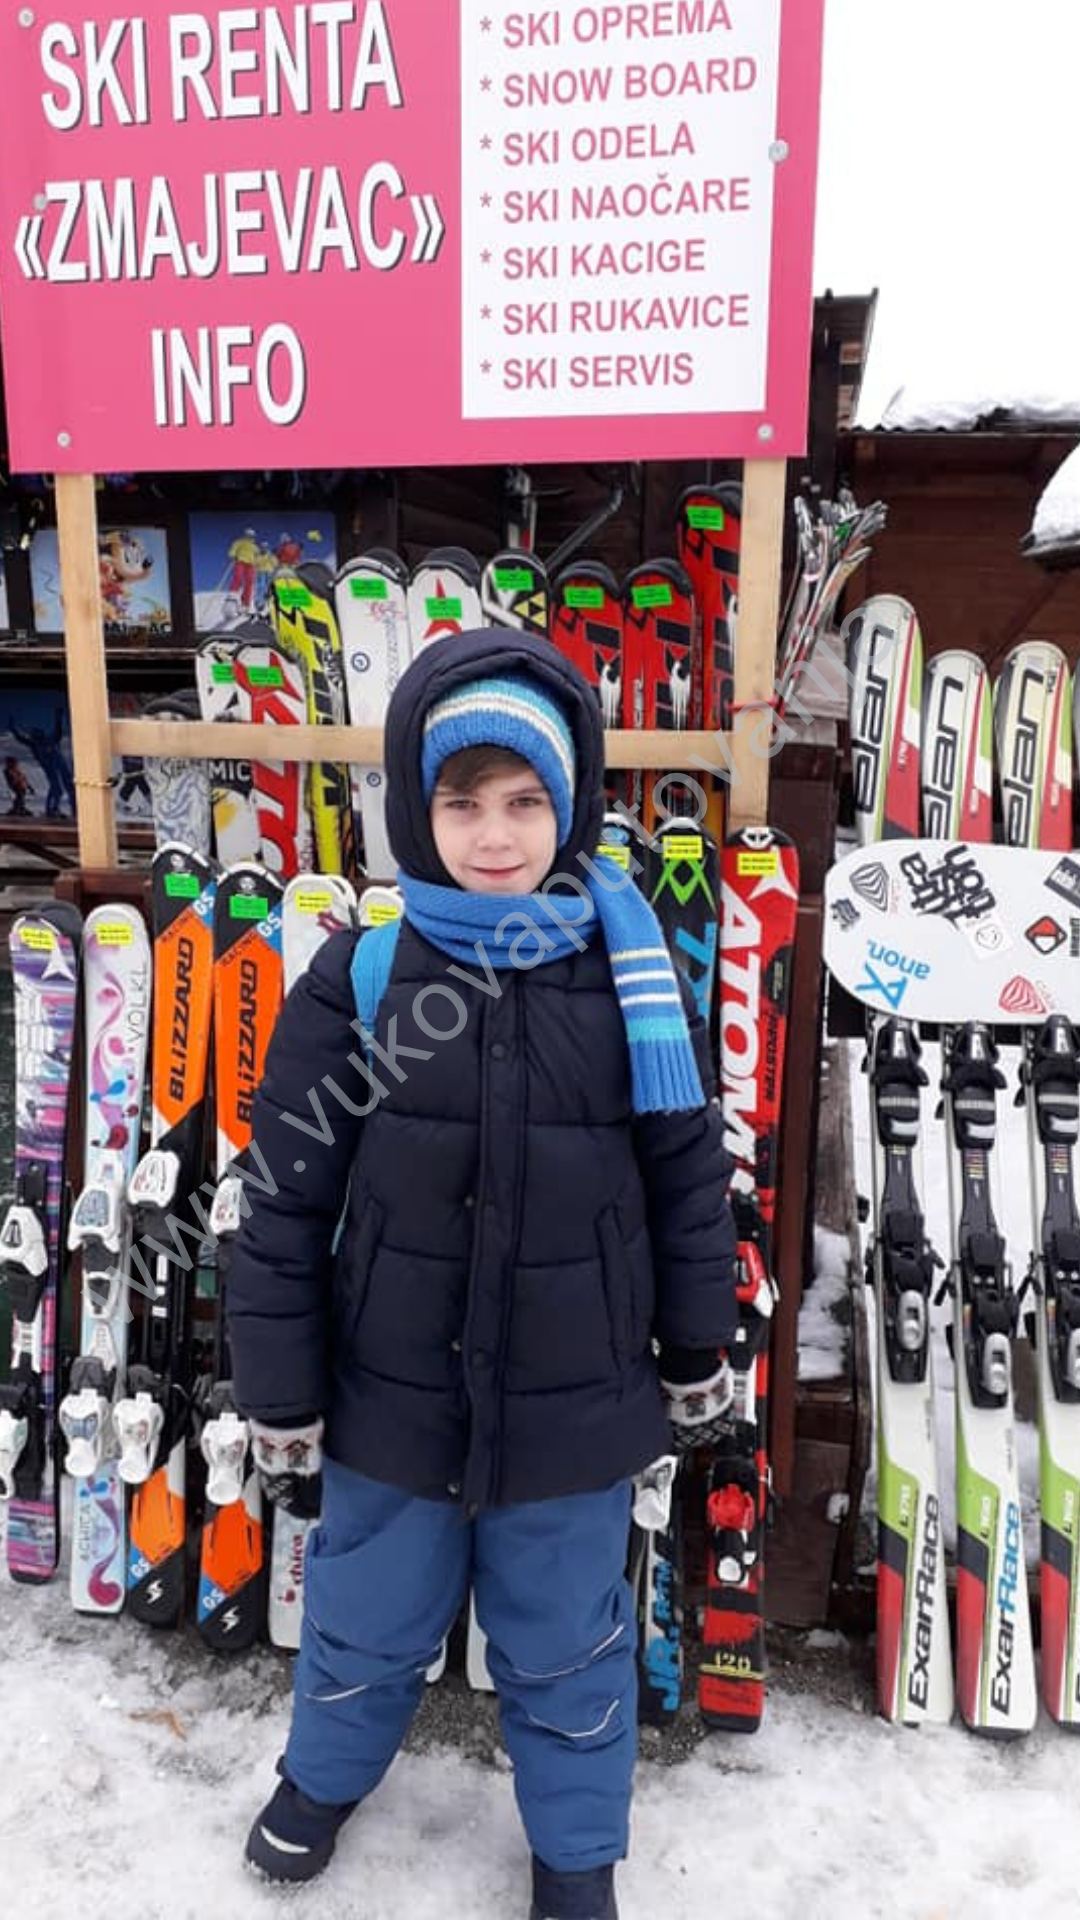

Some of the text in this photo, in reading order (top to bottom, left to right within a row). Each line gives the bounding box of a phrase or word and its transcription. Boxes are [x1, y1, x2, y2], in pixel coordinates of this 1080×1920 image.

[502, 0, 732, 49] SKI OPREMA
[40, 0, 403, 131] SKI RENTA
[502, 56, 757, 108] SNOW BOARD
[502, 121, 695, 166] SKI ODELA
[502, 173, 751, 224] SKI NAOČARE
[502, 239, 706, 280] SKI KACIGE
[502, 294, 750, 336] SKI RUKAVICE
[150, 322, 307, 427] INFO
[502, 352, 695, 390] SKI SERVIS
[193, 892, 215, 915] GS
[257, 913, 282, 937] GS
